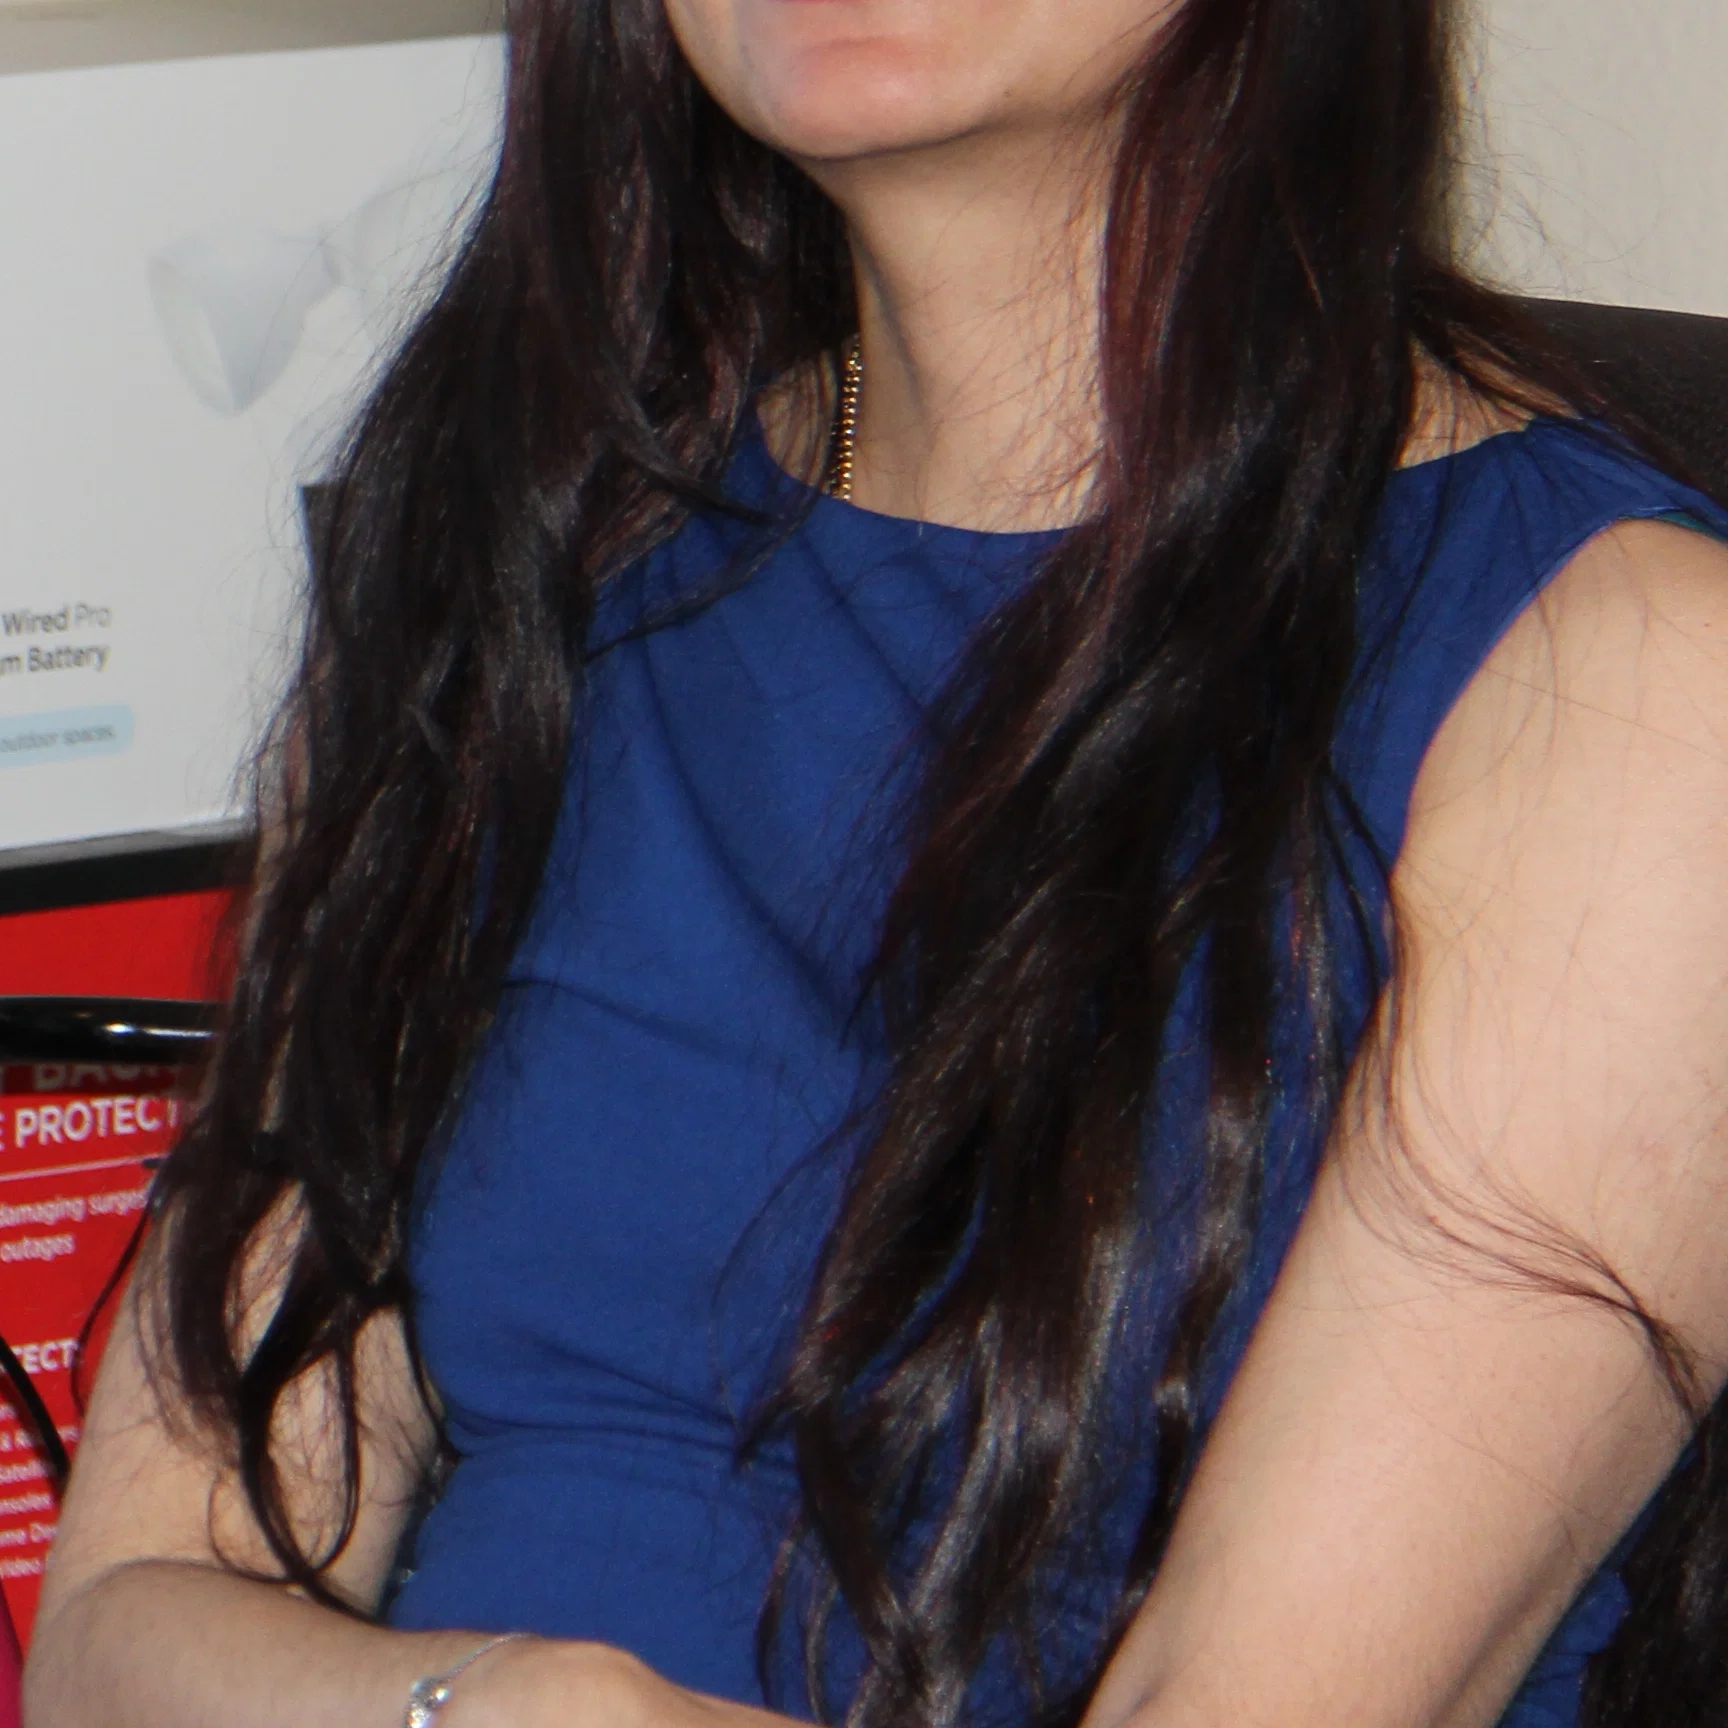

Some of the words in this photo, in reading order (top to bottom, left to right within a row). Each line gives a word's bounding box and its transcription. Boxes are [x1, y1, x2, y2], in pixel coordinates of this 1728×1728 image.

[2, 605, 70, 636] Wired
[74, 602, 113, 628] Pro
[28, 644, 111, 672] Battery
[0, 1234, 76, 1263] outages
[0, 1431, 12, 1452] &
